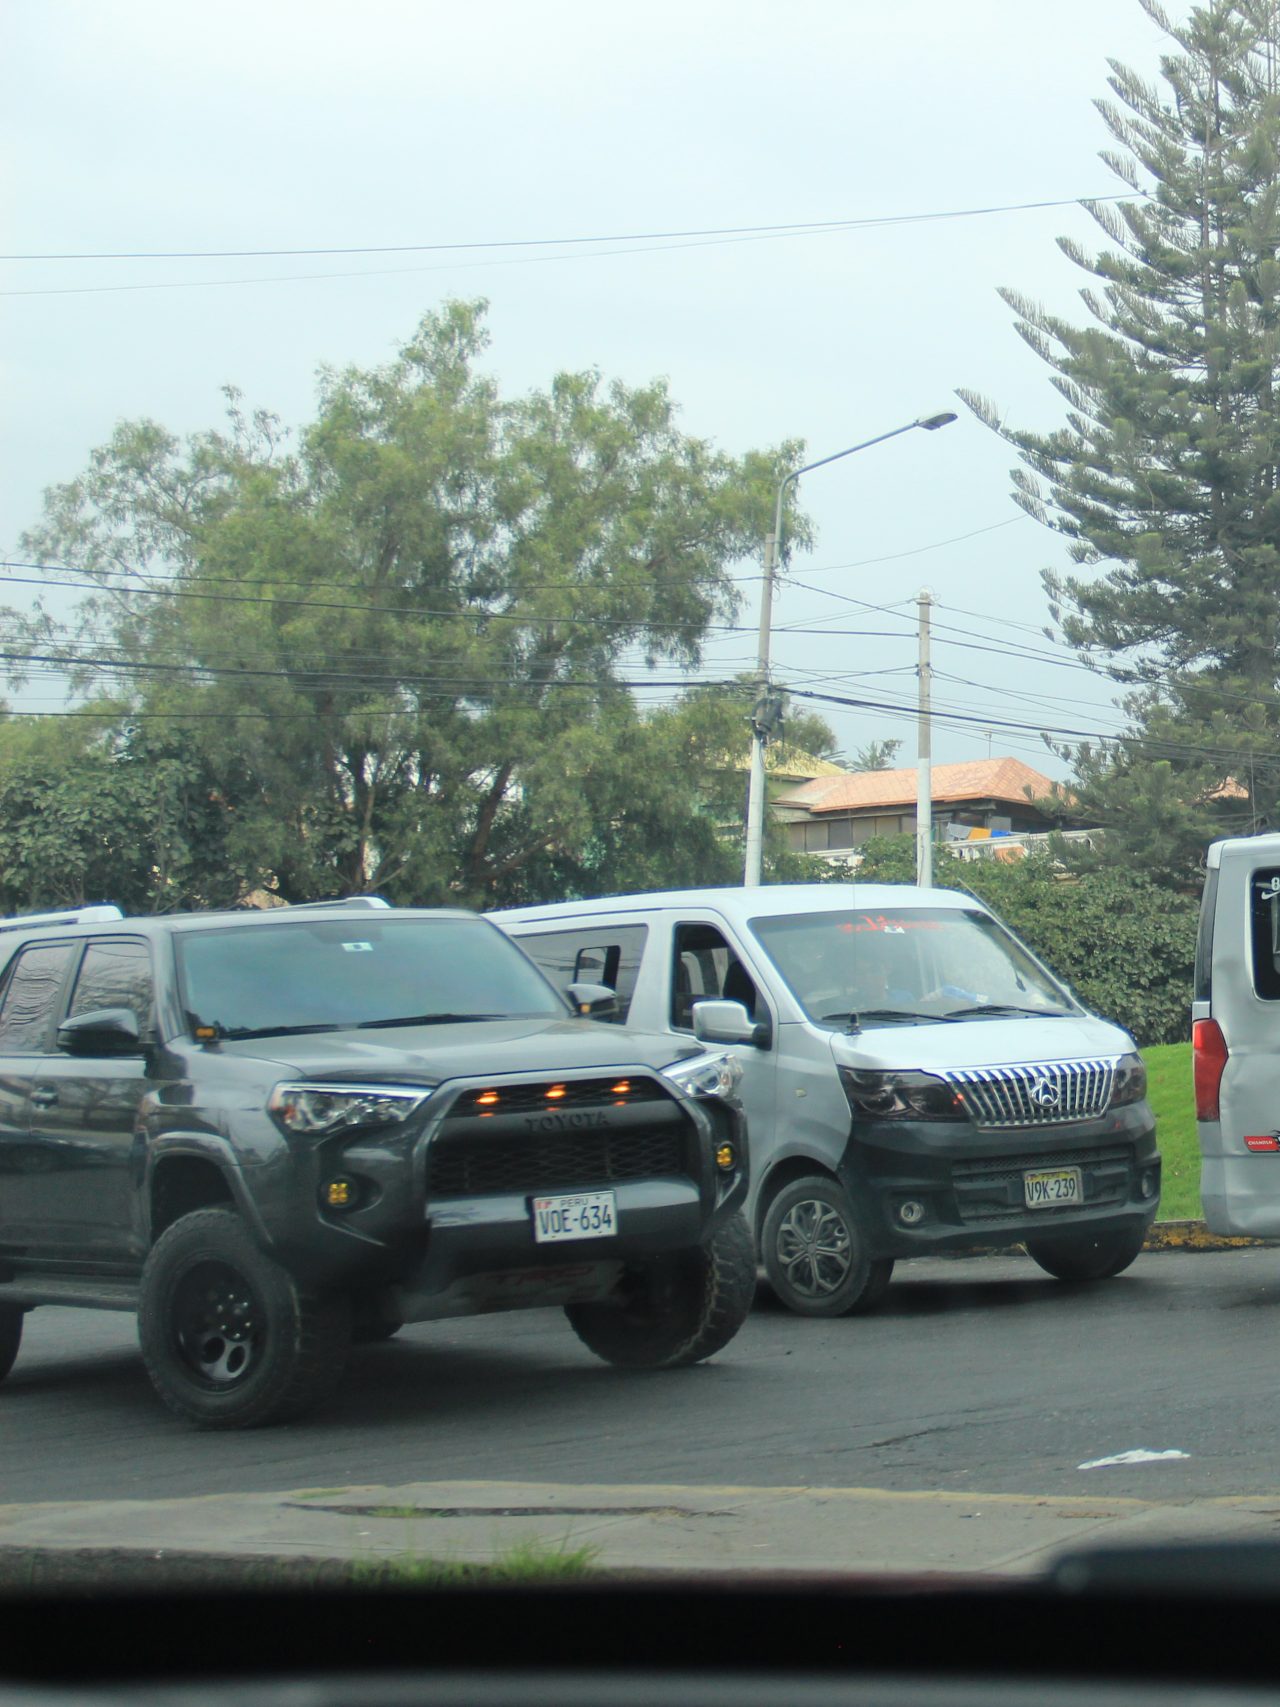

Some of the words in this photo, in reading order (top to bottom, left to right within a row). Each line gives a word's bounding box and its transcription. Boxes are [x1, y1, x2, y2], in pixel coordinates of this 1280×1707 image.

[525, 1110, 610, 1132] TOYOTA
[1026, 1177, 1076, 1202] V9K-239
[560, 1198, 590, 1208] PERU
